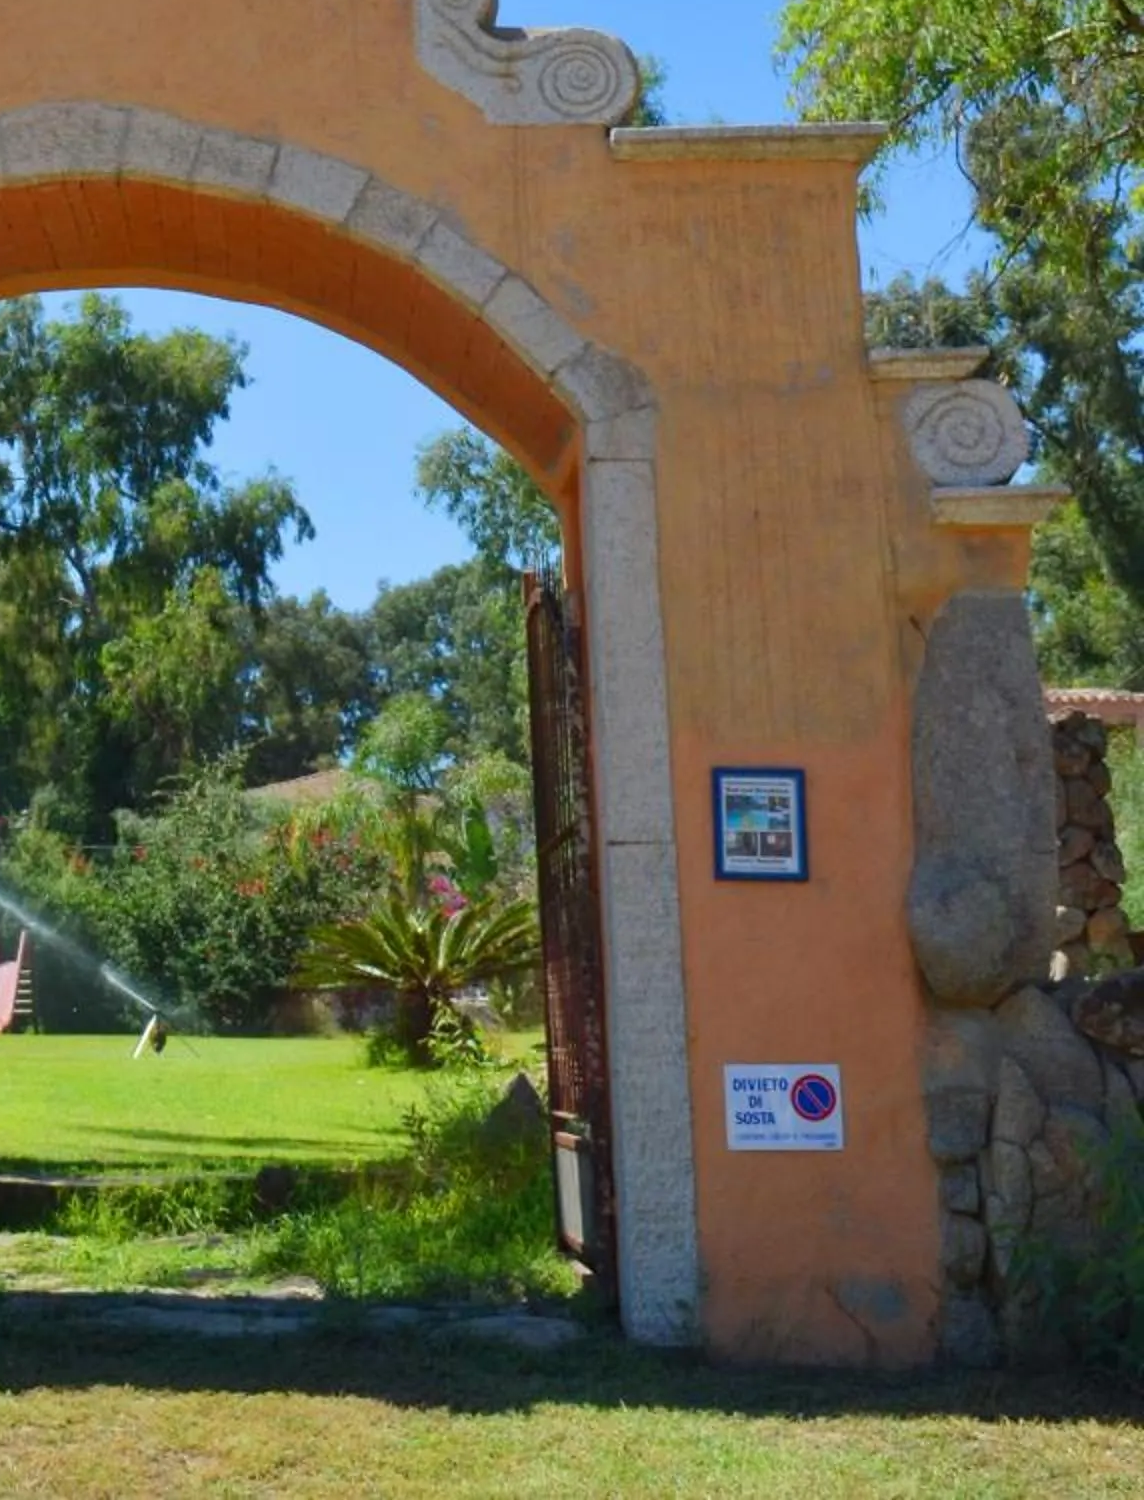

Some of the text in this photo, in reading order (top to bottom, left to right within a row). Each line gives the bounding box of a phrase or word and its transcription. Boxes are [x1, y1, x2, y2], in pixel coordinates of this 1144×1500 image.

[733, 1078, 788, 1092] DIVIETO
[748, 1095, 762, 1109] DI
[735, 1111, 776, 1125] SOSTA
